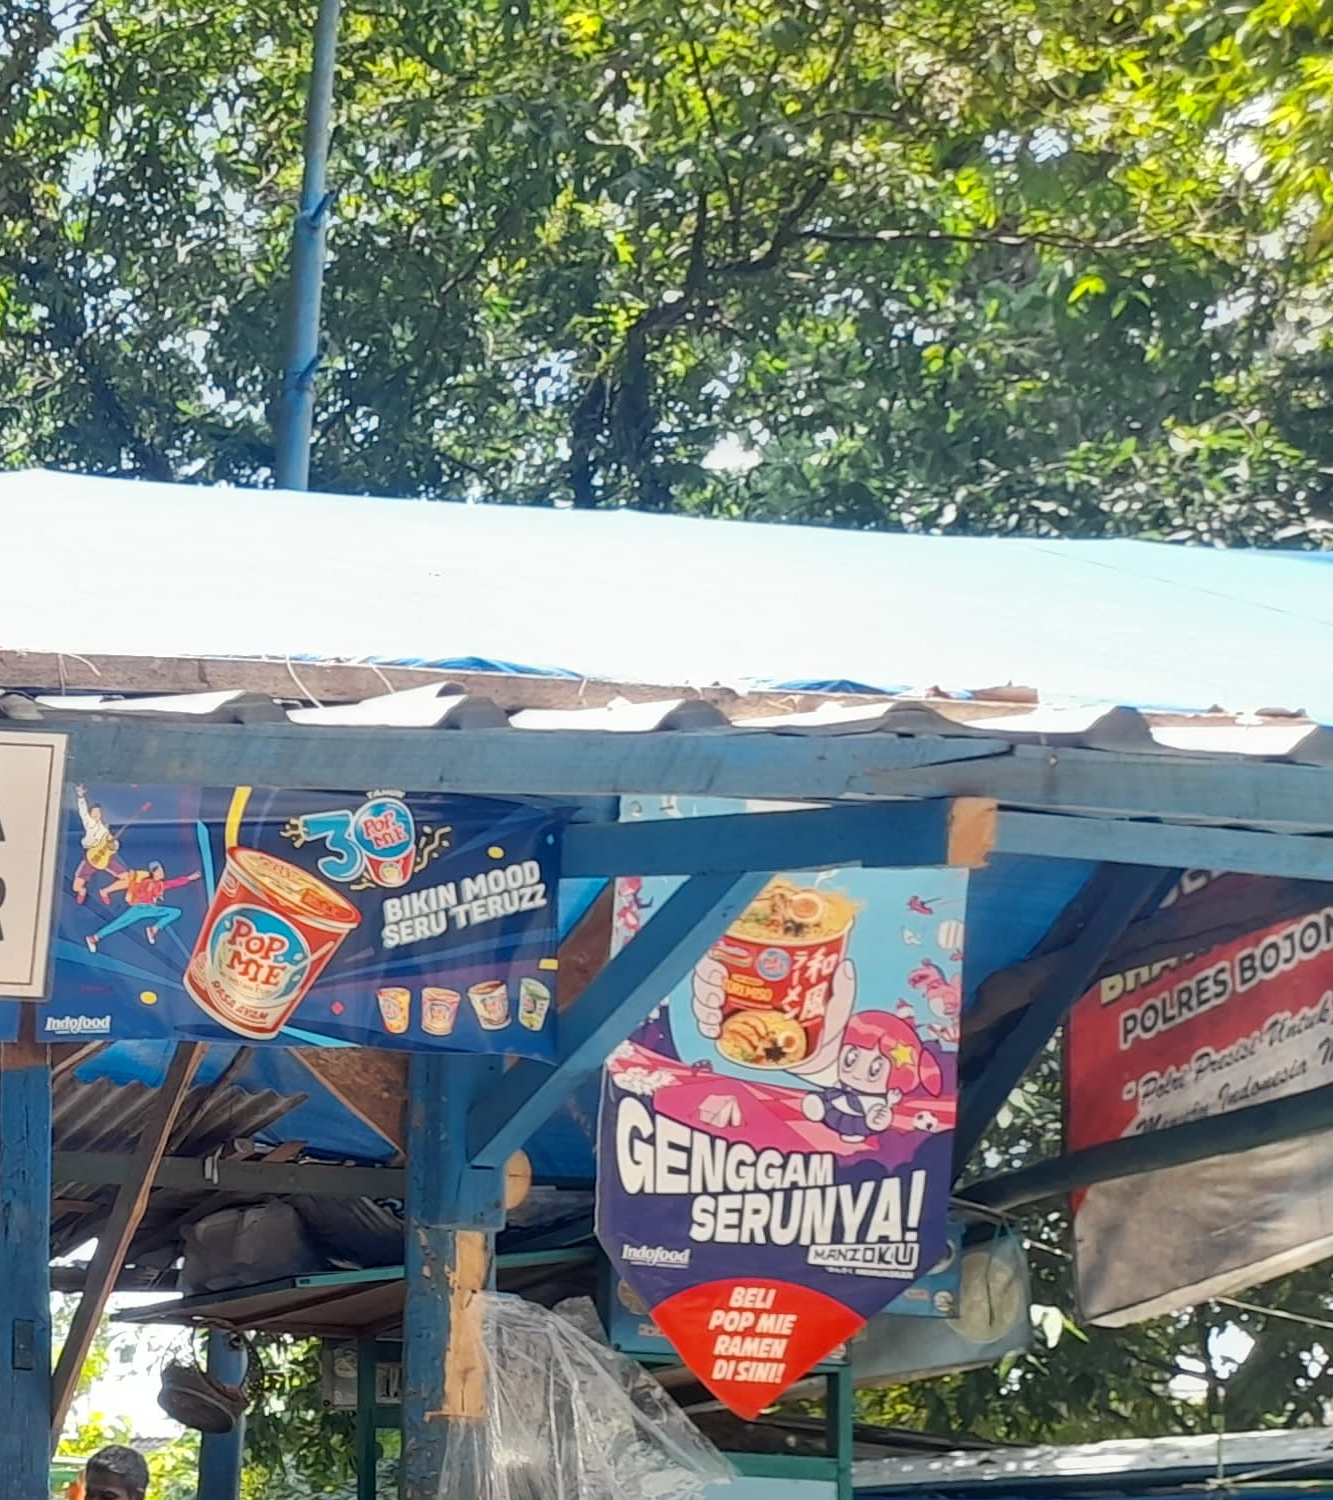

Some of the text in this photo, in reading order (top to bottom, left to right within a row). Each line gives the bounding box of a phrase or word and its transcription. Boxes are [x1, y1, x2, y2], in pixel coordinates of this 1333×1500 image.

[383, 861, 542, 923] BIKIN MOOD
[383, 884, 548, 950] SERU TERUZZ
[227, 919, 288, 962] POP
[227, 953, 286, 988] MIE
[1121, 963, 1231, 1046] POLRES
[45, 1015, 112, 1034] Indofood
[615, 1097, 834, 1195] GENGGAM
[688, 1169, 928, 1247] SERUNYA!
[621, 1244, 692, 1266] Indofood
[812, 1243, 916, 1268] MANZOKU
[728, 1286, 776, 1309] BELI
[707, 1310, 798, 1336] POP MIE
[713, 1334, 789, 1360] RAMEN
[711, 1359, 787, 1384] DI SINI!
